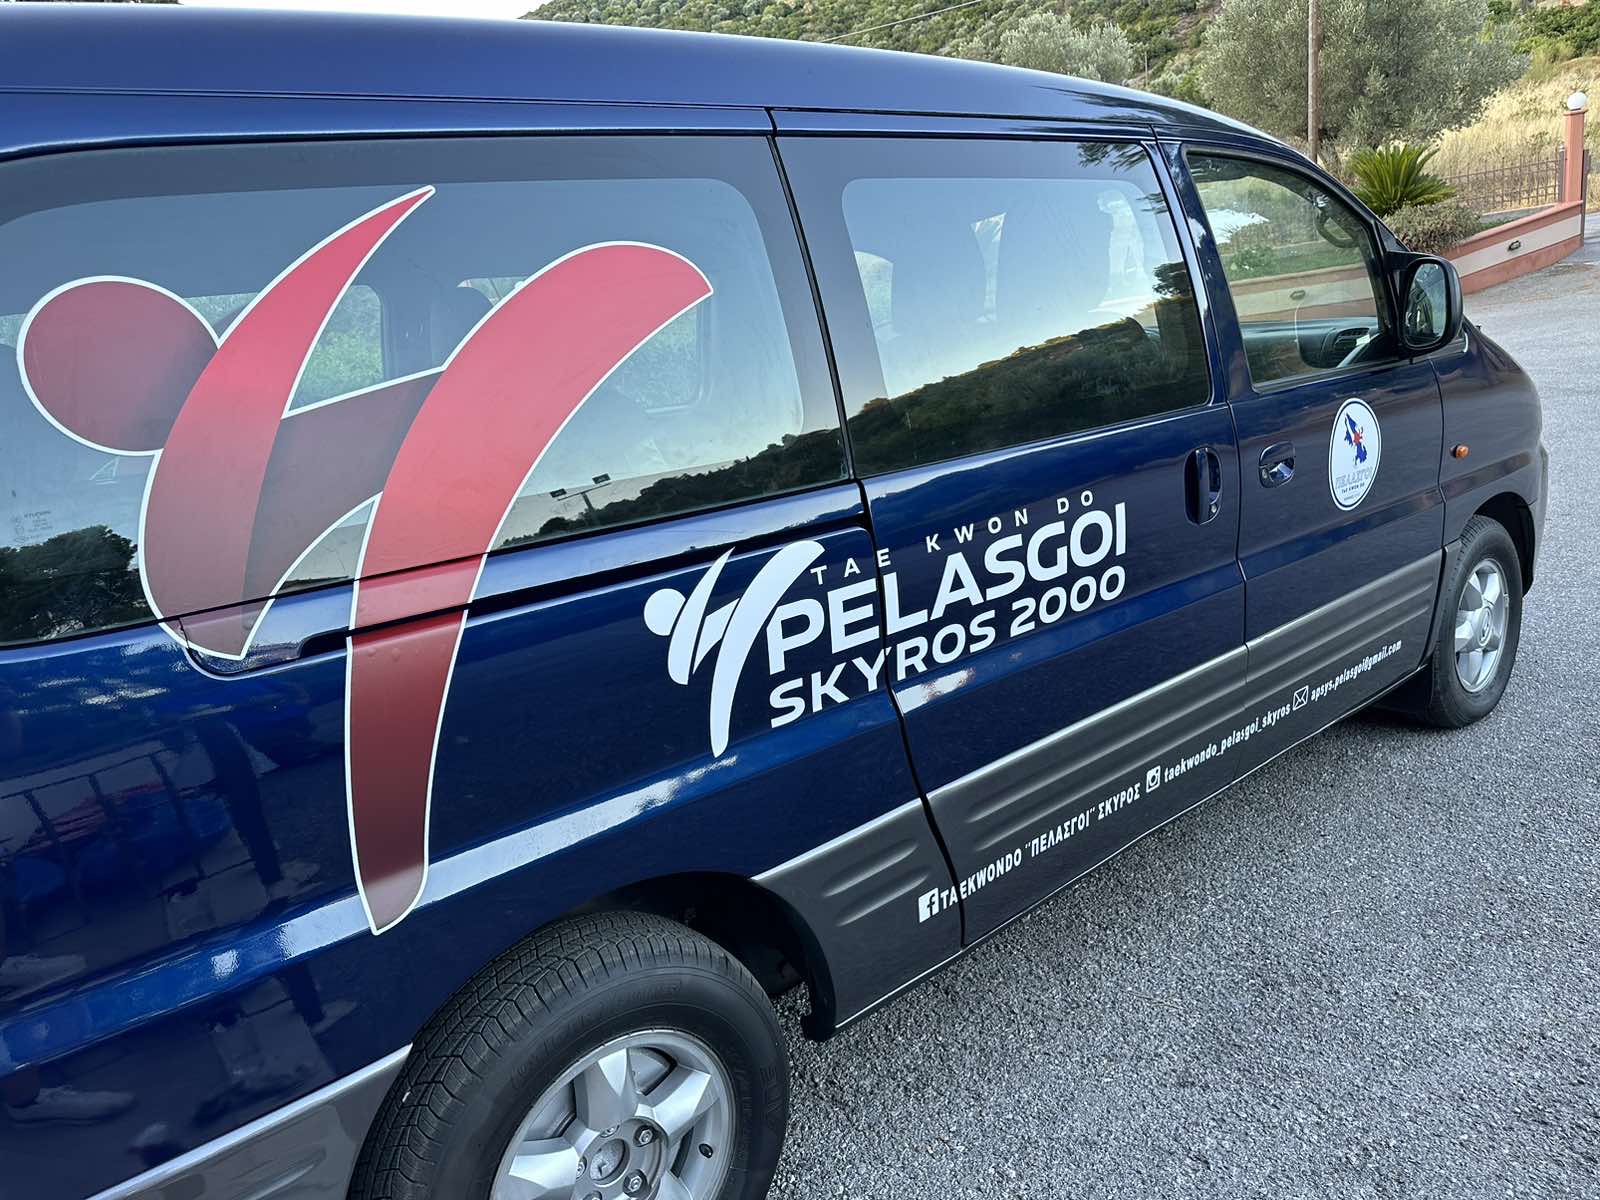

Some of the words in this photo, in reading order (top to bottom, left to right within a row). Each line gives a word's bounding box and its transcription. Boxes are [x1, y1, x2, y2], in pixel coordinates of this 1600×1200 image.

[766, 502, 1128, 676] PELASGOI
[810, 547, 891, 586] TAE
[926, 508, 1029, 553] KWON
[1056, 490, 1095, 514] DO
[770, 614, 997, 728] SKYROS
[1009, 565, 1127, 637] 2000
[1310, 639, 1402, 701] apsys.pelasgoi@gmail.com
[1164, 702, 1291, 783] taekwondo_pelasgoi_skyros
[940, 848, 1022, 910] TAEKWONDO
[1097, 783, 1141, 820] ΣΚΥΡΟΣ
